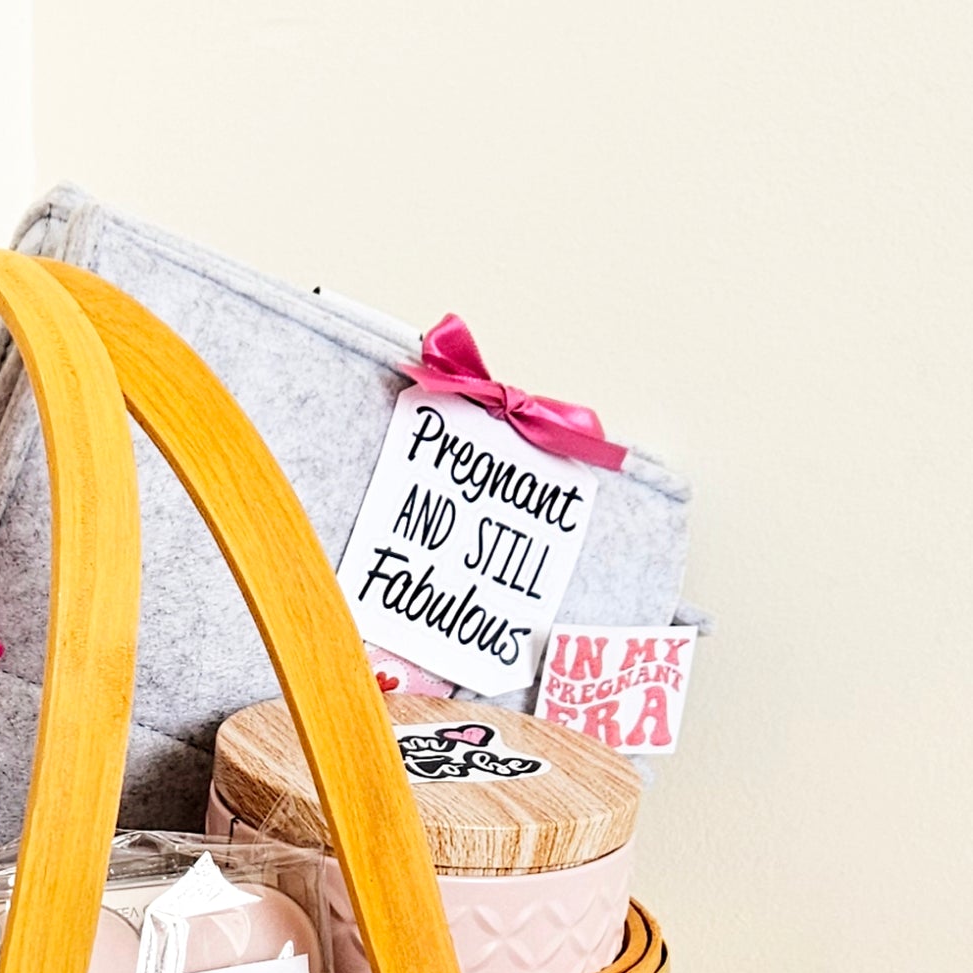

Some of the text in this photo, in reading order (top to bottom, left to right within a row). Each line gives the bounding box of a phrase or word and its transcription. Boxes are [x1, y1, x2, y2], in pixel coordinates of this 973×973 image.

[407, 406, 584, 532] Pregnant
[392, 483, 551, 600] AND STILL
[358, 547, 531, 665] Fabulous
[545, 665, 683, 705] PREGNANT
[550, 634, 690, 681] IN MY
[545, 685, 673, 748] ERA
[404, 751, 534, 777] to be
